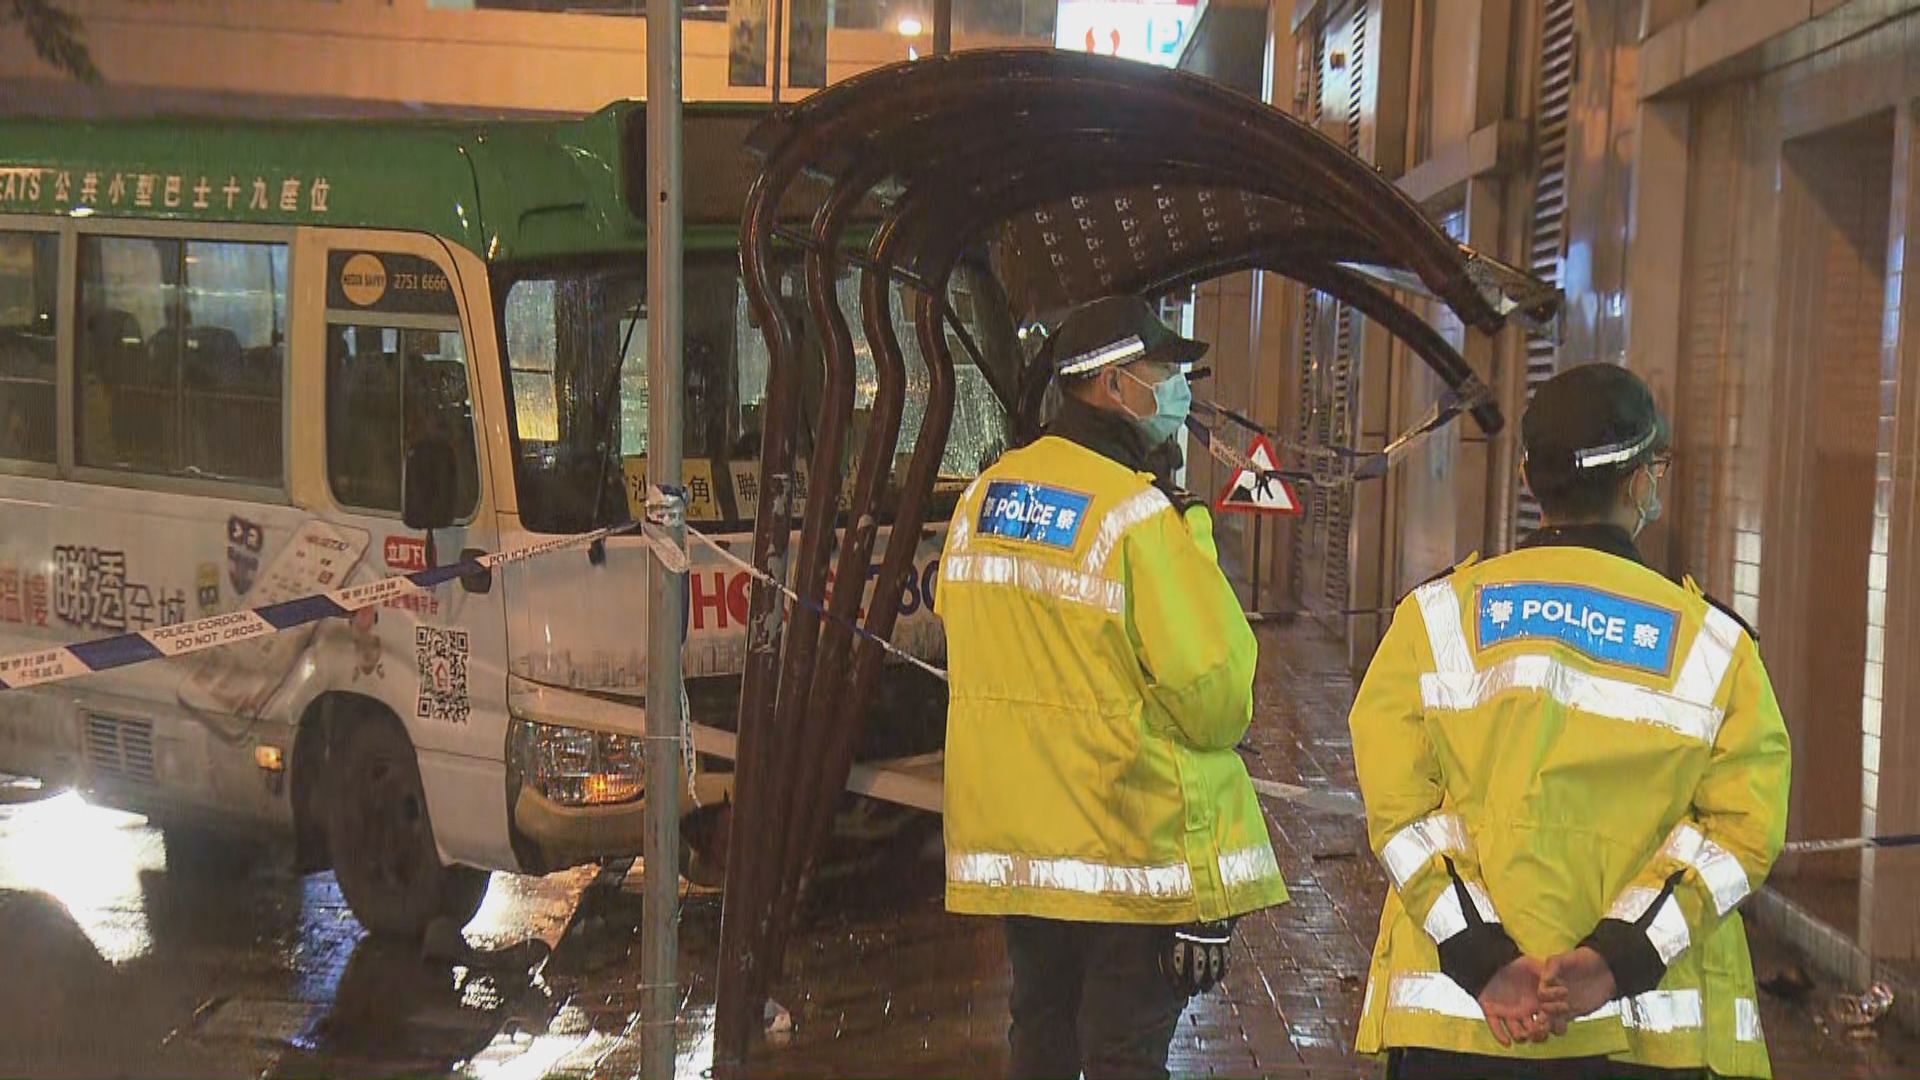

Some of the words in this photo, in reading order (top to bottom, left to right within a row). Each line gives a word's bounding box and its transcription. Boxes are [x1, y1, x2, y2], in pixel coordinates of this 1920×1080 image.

[0, 171, 41, 201] ATS
[55, 171, 331, 212] 公共小型巴士十九座位
[393, 273, 417, 289] 2751
[422, 274, 447, 291] 6666
[994, 497, 1057, 526] POLICE
[153, 625, 195, 640] POLICE
[175, 638, 193, 650] DO
[195, 632, 218, 646] NOT
[223, 622, 263, 639] CROSS
[1522, 600, 1626, 644] POLICE
